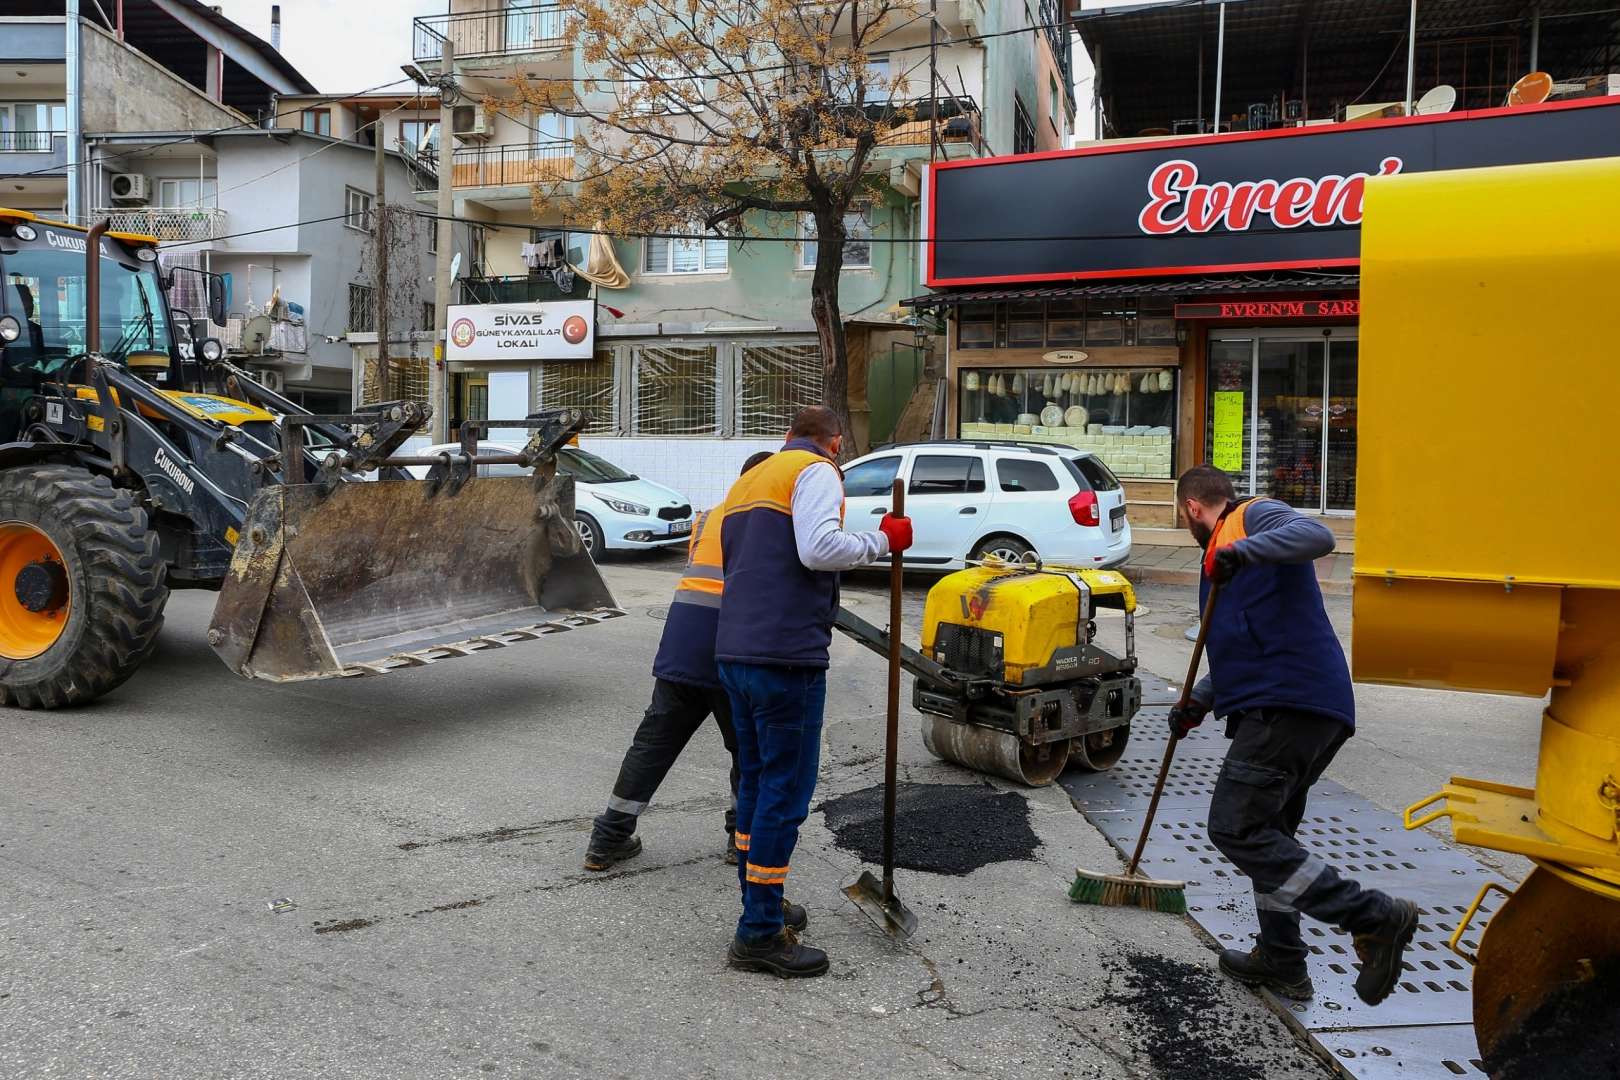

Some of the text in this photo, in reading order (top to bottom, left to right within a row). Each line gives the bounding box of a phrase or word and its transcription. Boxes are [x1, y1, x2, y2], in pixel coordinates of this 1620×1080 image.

[46, 230, 108, 254] ÇUKURA
[1221, 303, 1305, 316] EVREN'M
[494, 313, 543, 326] SİVAS
[476, 329, 561, 337] GÜNEYKAYALILAR
[497, 338, 538, 348] LOKALİ
[154, 447, 195, 496] ÇUKUROVA
